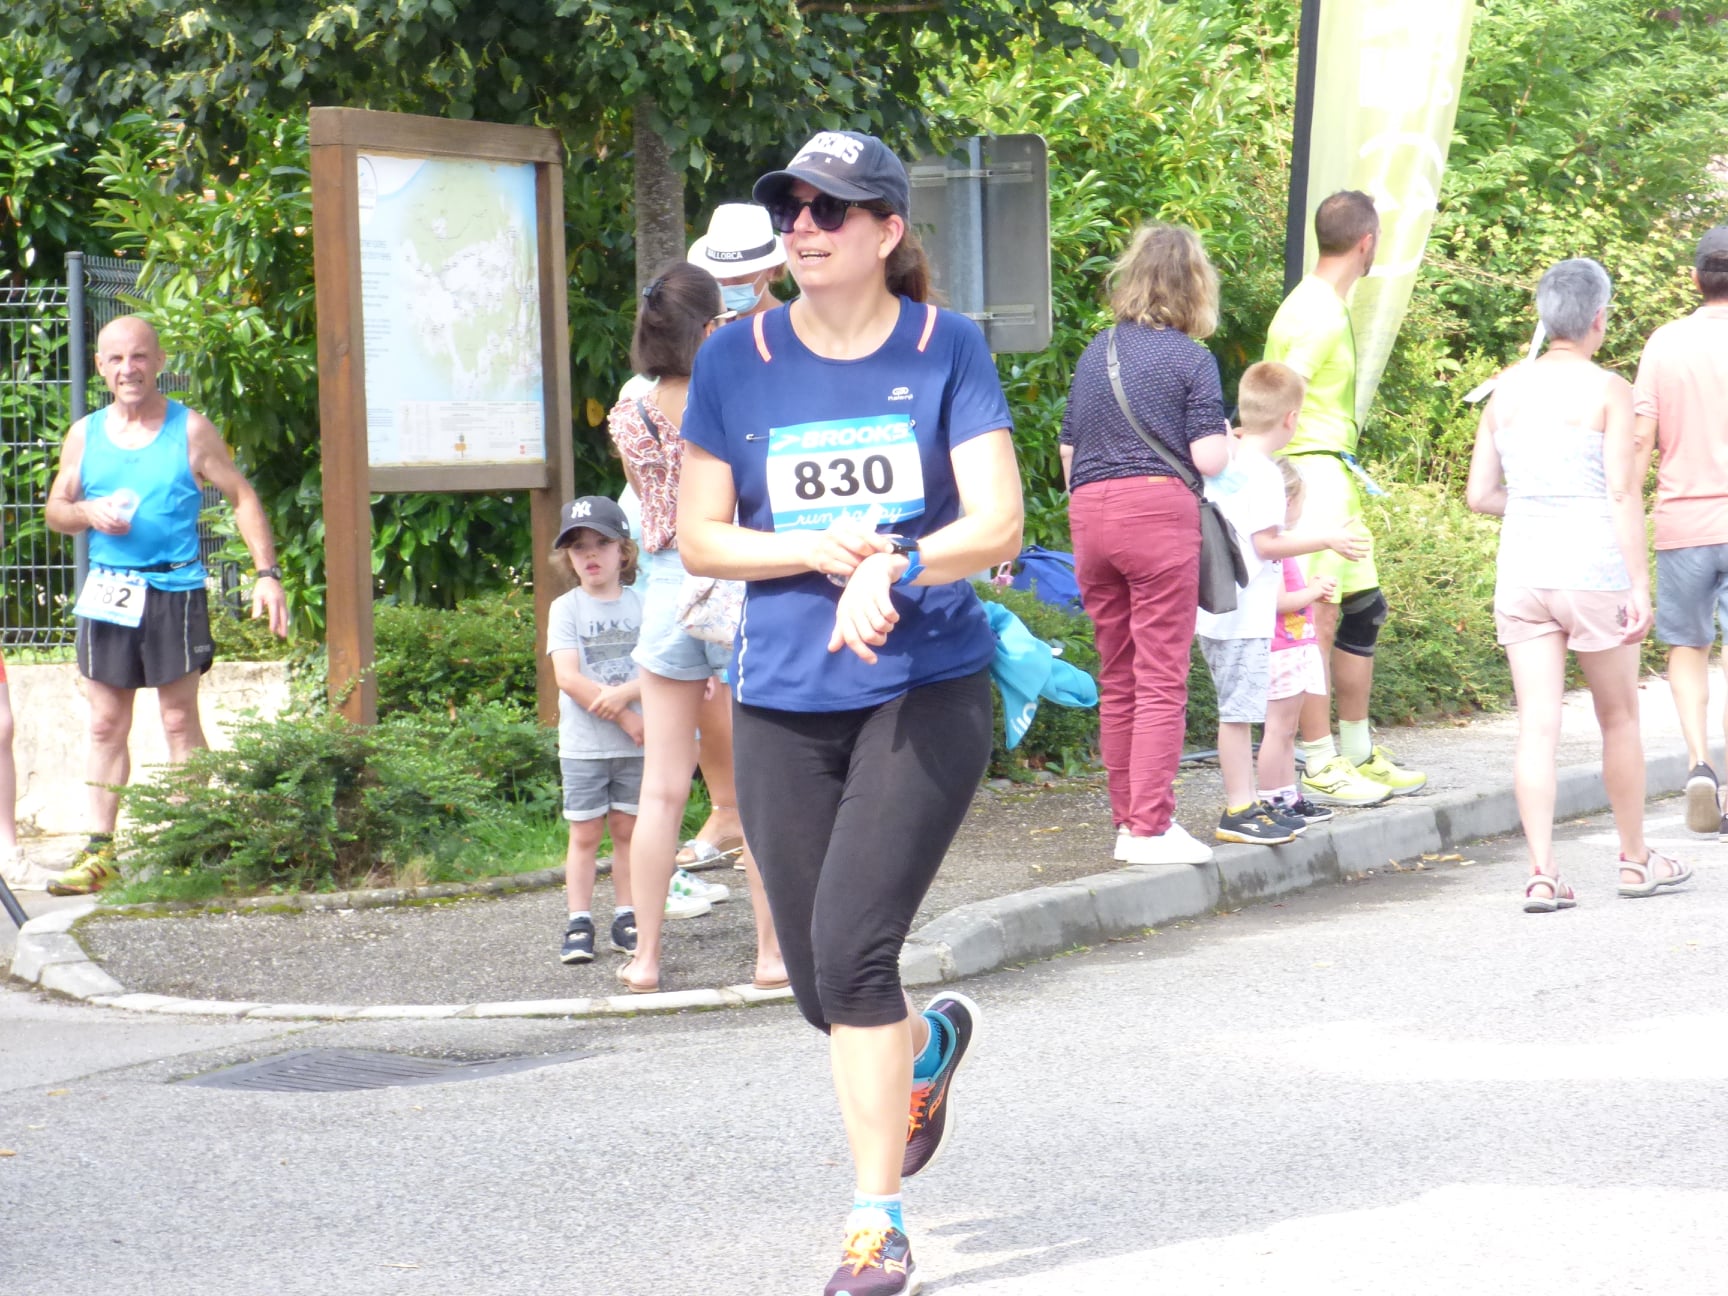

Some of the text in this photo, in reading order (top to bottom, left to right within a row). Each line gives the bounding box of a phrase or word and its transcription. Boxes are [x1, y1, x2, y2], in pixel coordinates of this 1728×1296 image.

[800, 422, 909, 448] BROOKS
[794, 454, 894, 500] 830
[795, 512, 833, 526] run
